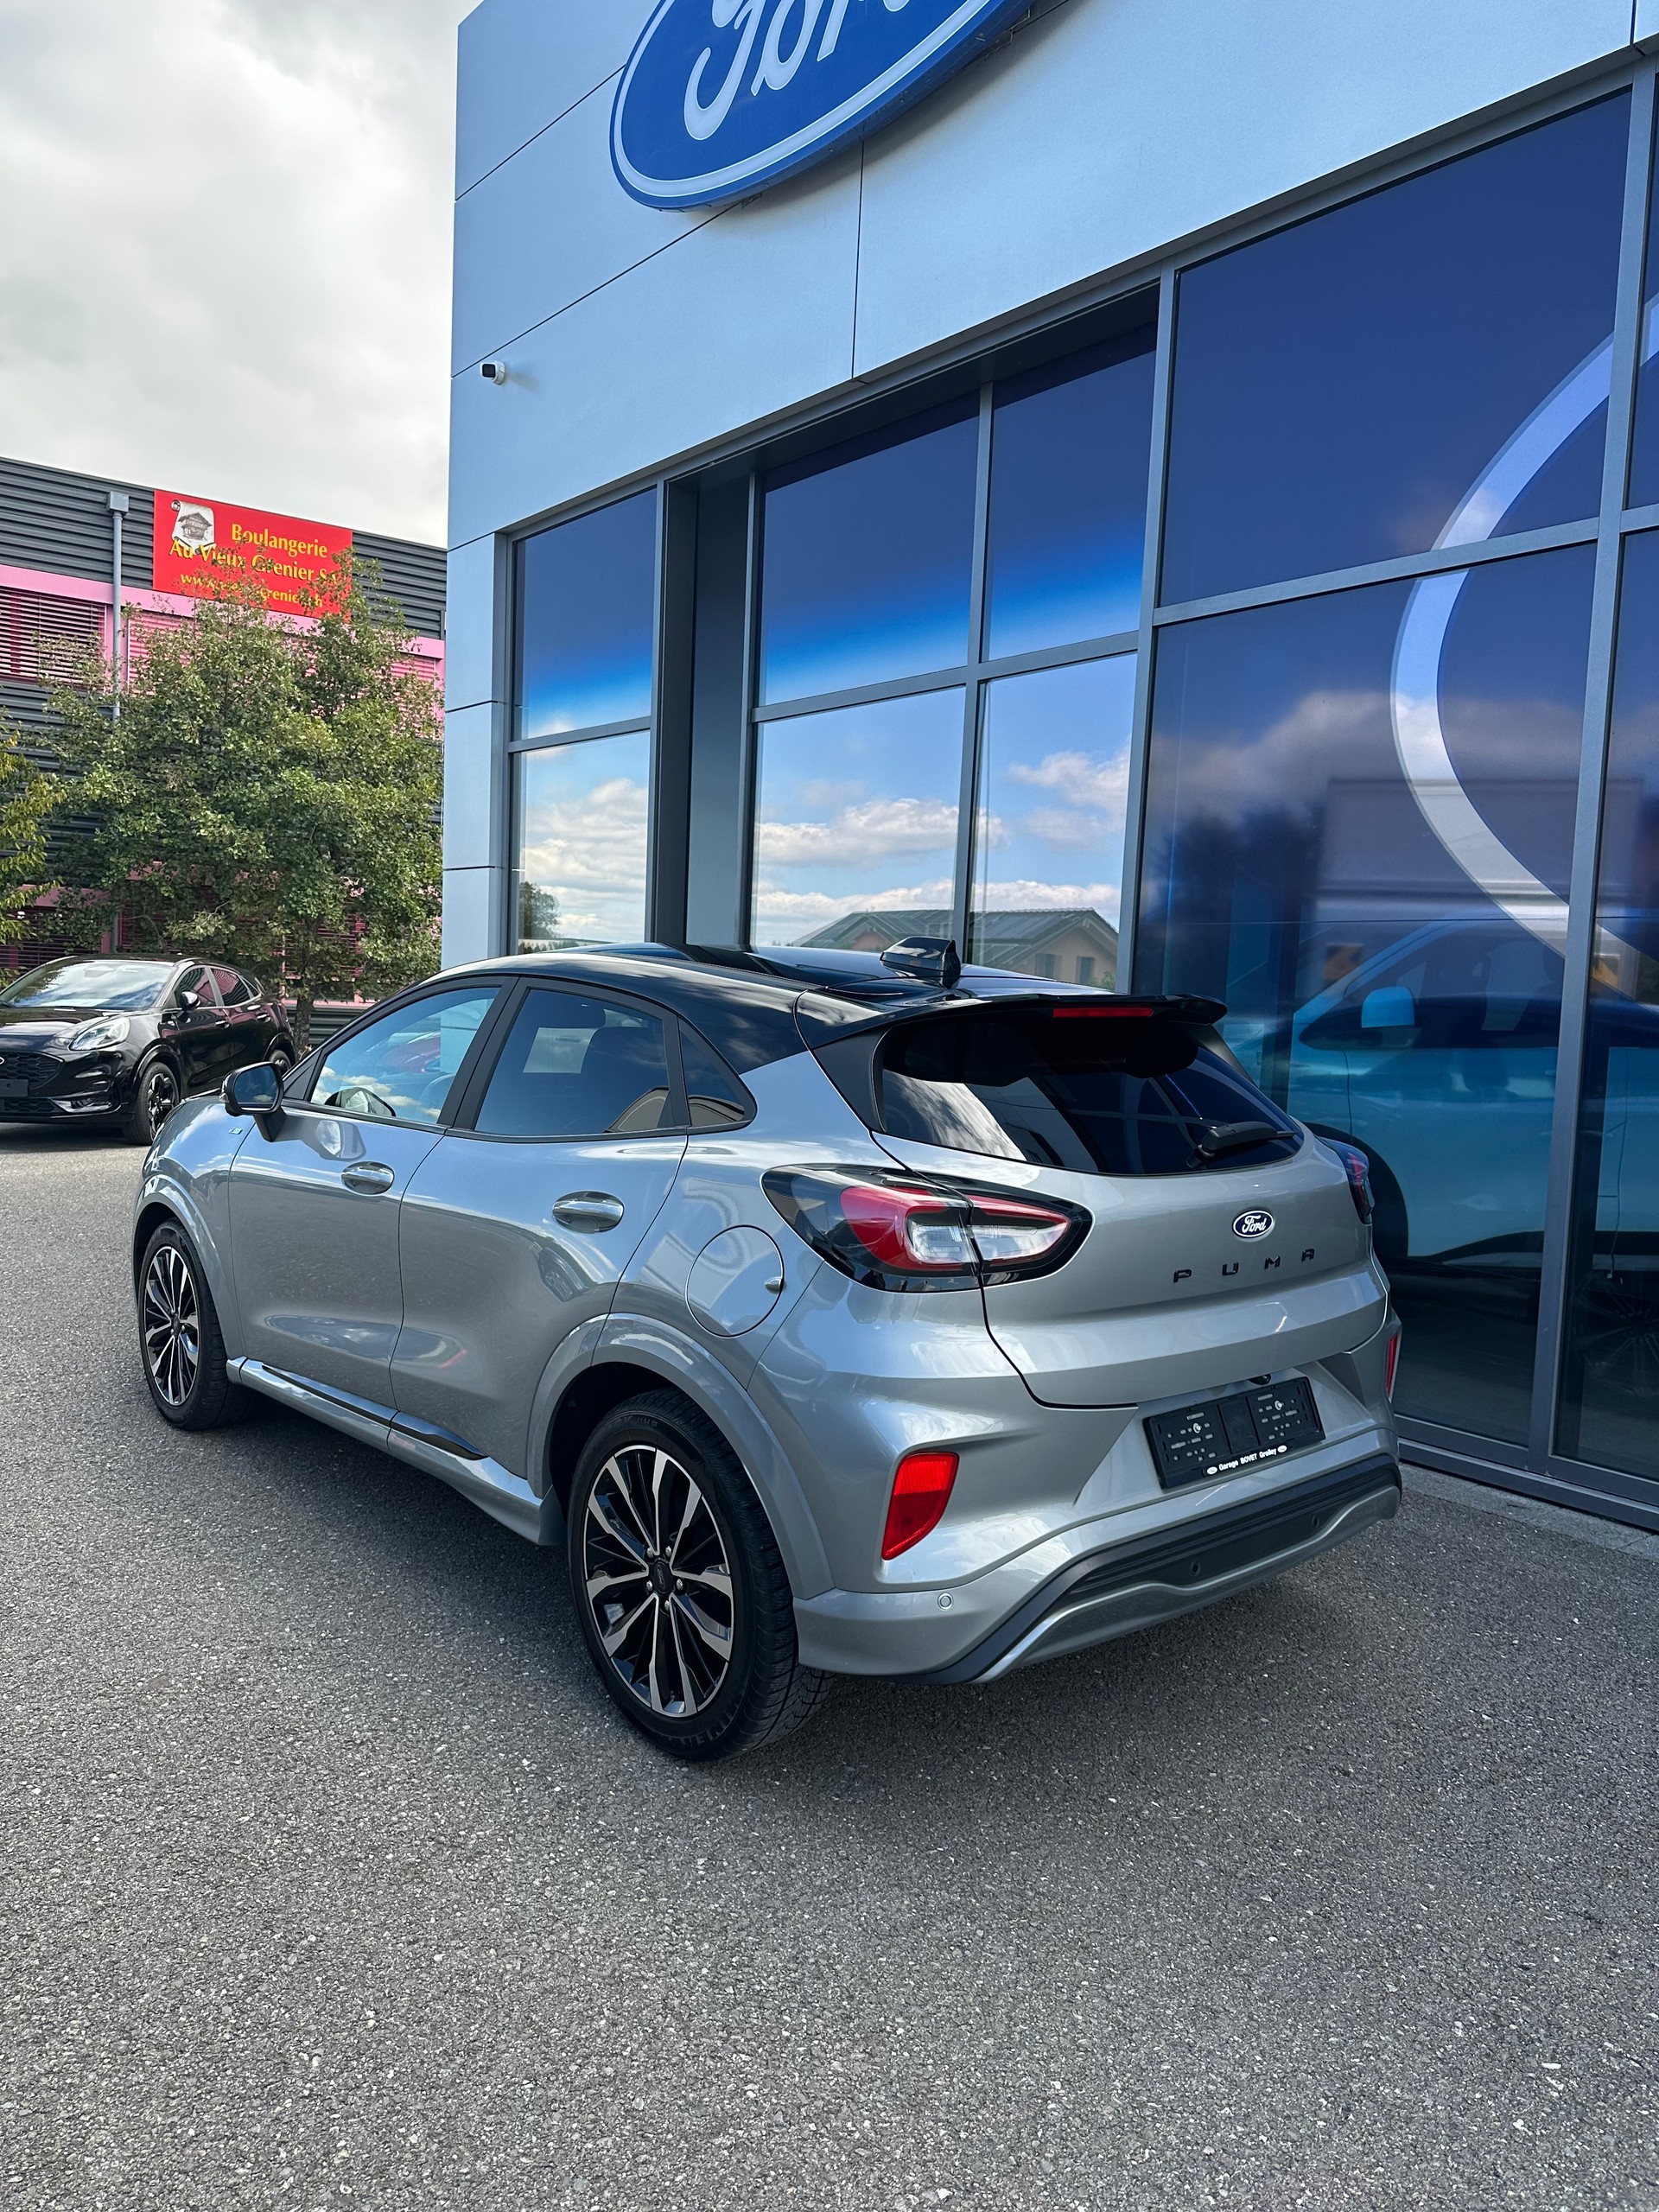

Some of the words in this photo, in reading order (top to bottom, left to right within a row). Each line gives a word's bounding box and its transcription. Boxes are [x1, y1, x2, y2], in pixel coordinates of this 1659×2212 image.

[169, 537, 193, 560] Au
[231, 523, 328, 559] Boulangerie
[1240, 1213, 1268, 1234] Ford
[1173, 1248, 1316, 1283] PUMA
[1218, 1459, 1239, 1471] Garage
[1240, 1452, 1258, 1465] BOVET
